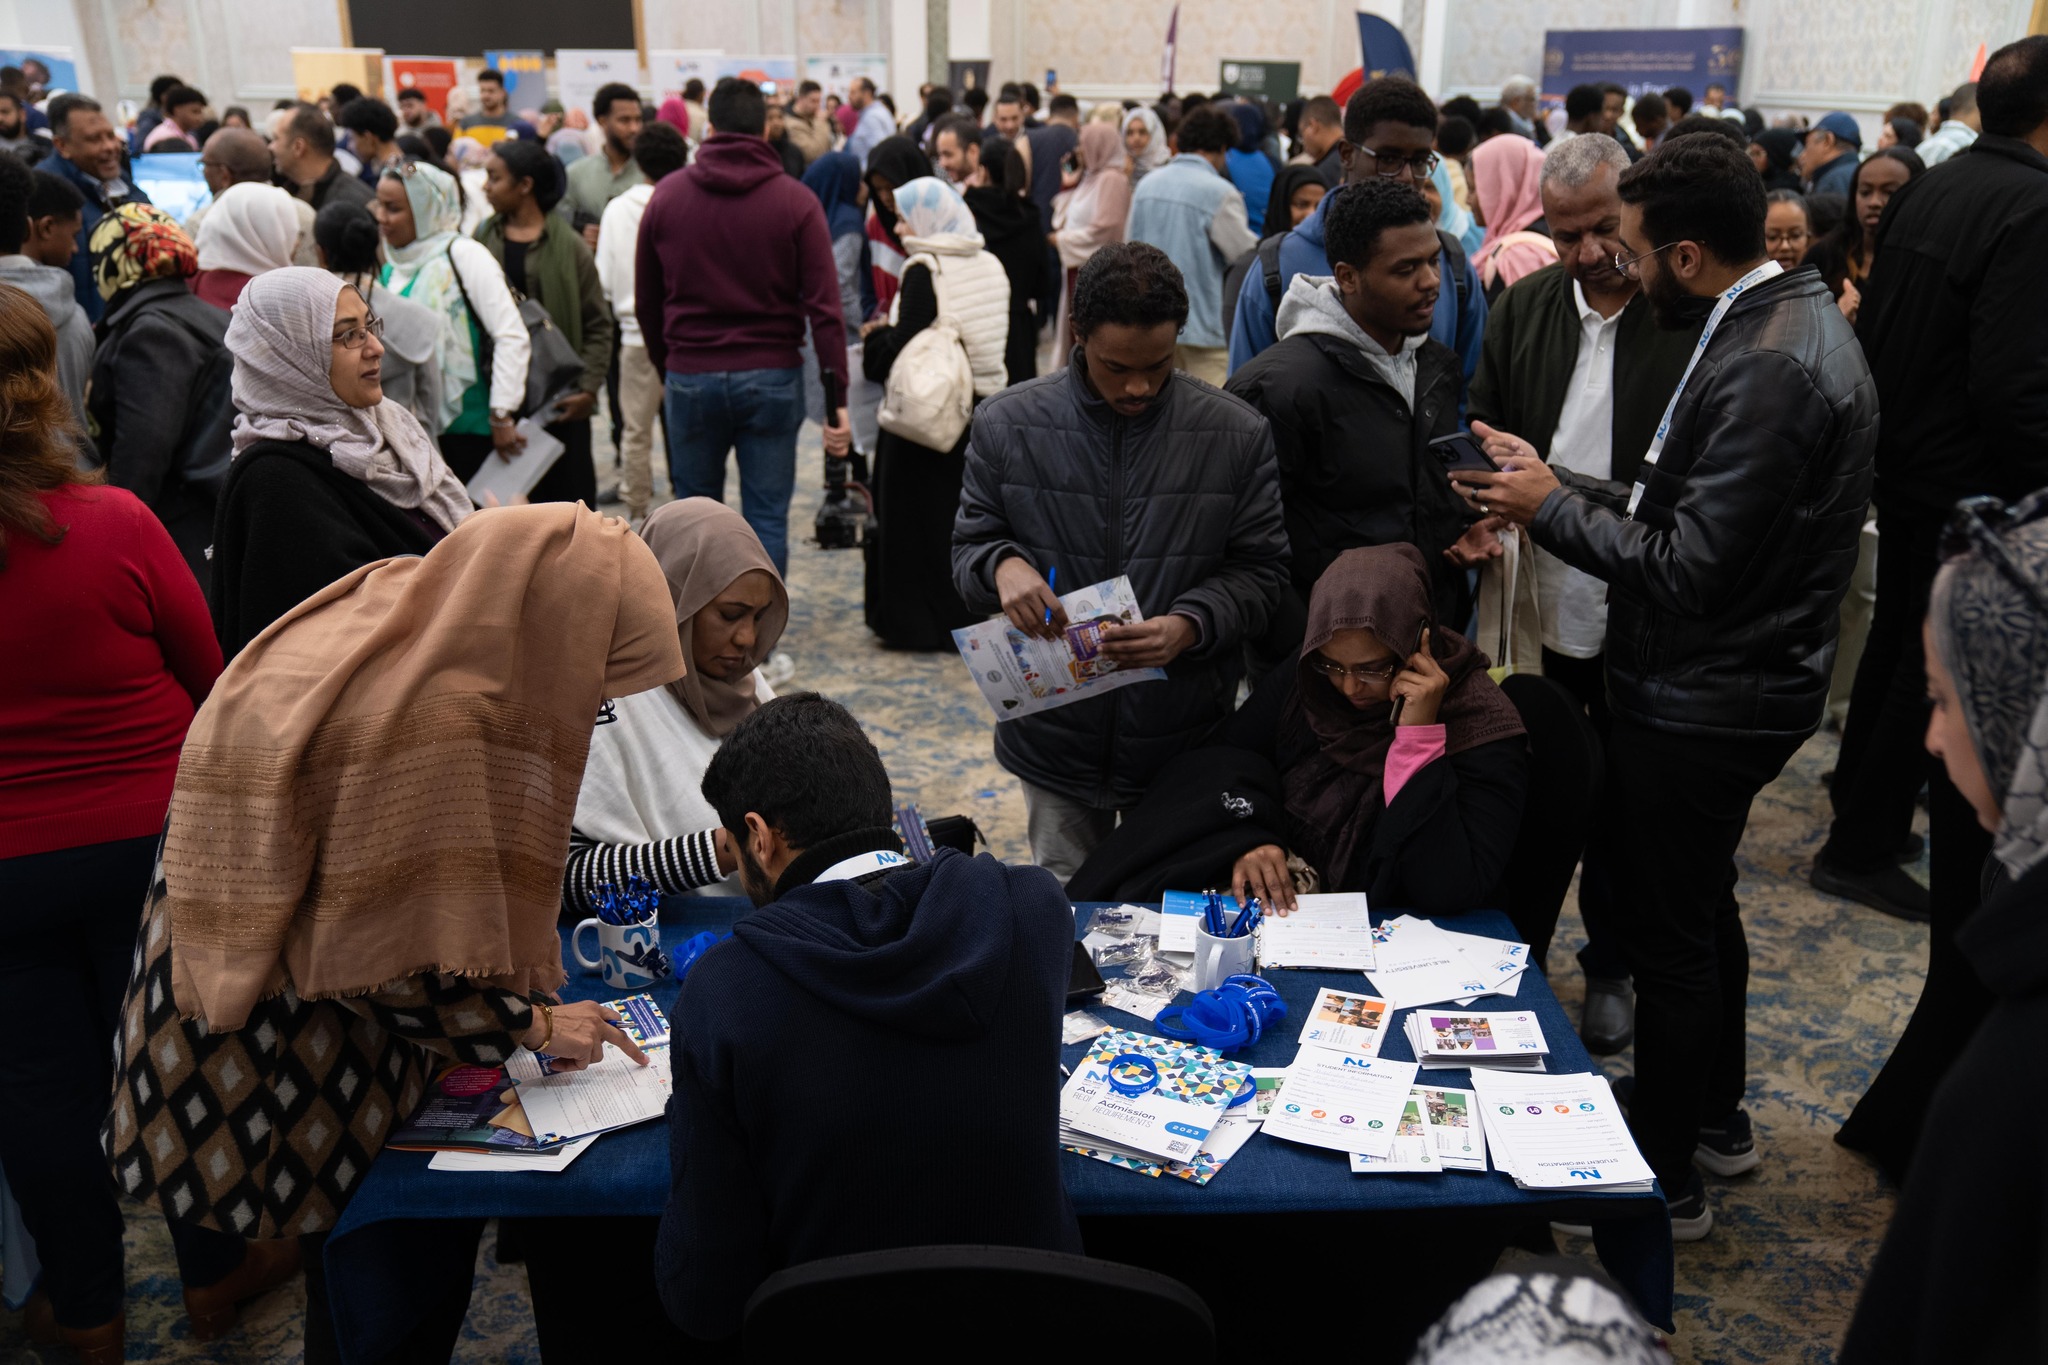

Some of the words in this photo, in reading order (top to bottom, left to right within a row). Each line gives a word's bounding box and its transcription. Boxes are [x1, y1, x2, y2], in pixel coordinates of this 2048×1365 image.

[875, 852, 898, 866] NU
[1385, 962, 1432, 974] UNIVERSITY
[1343, 1056, 1372, 1068] NU
[1317, 1063, 1347, 1072] STUDENT
[1347, 1069, 1393, 1080] INFORMATION
[1092, 1105, 1153, 1128] REQUIREMENTS
[1097, 1099, 1156, 1121] Admission
[1172, 1125, 1199, 1136] 2023
[1570, 1169, 1602, 1180] NU
